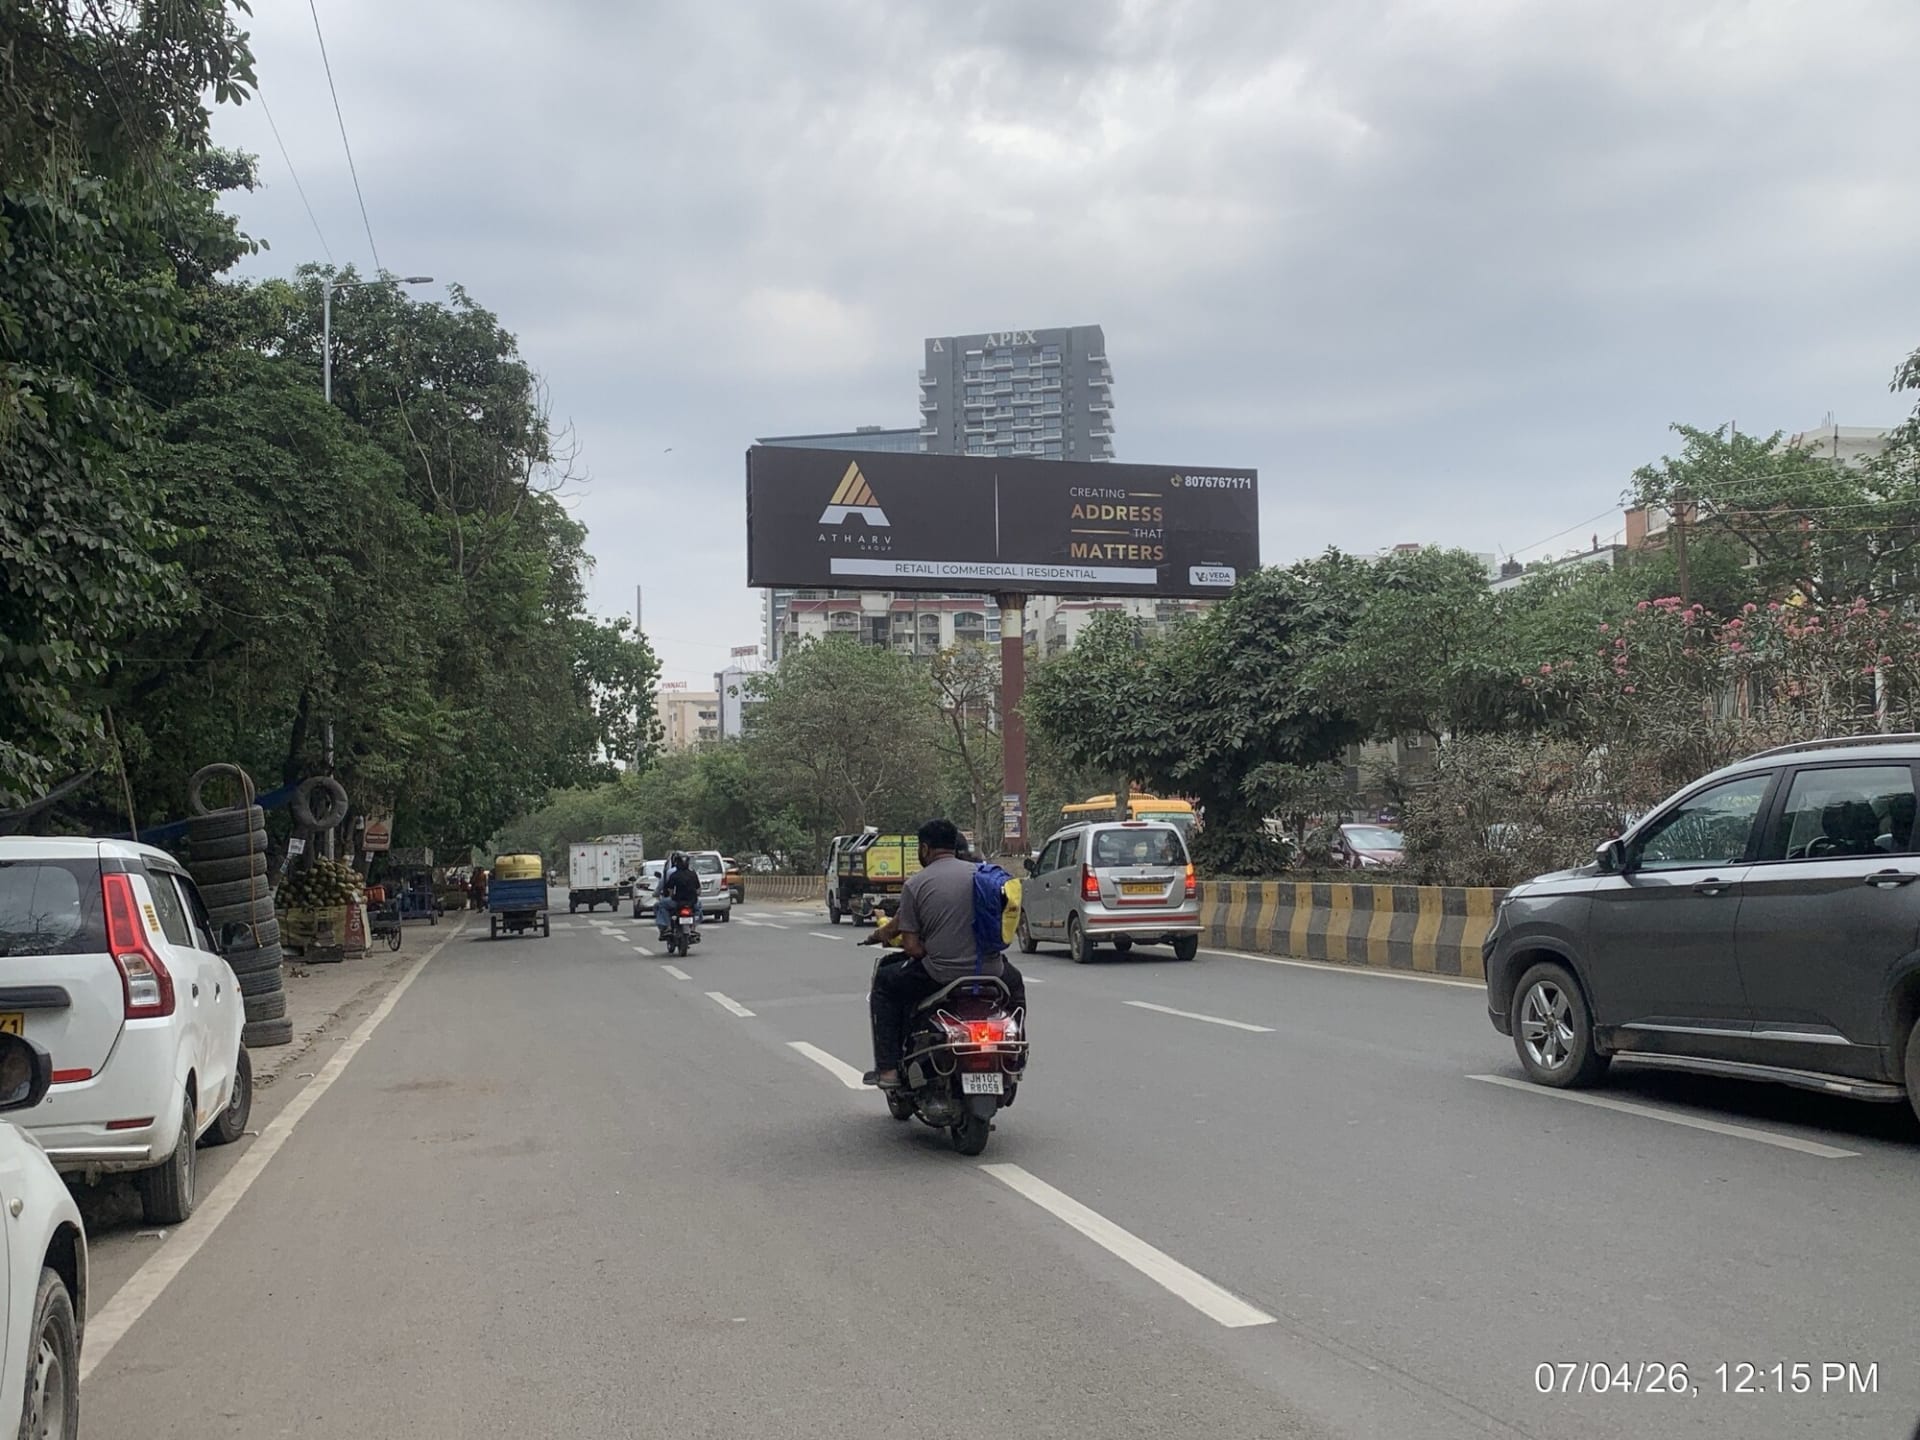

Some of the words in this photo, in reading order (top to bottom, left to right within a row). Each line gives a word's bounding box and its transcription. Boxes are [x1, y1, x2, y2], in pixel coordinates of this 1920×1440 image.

[985, 330, 1037, 348] APEX
[1184, 475, 1251, 489] 8076767171
[1069, 487, 1126, 499] CREATING
[1071, 504, 1163, 522] ADDRESS
[818, 533, 892, 544] ATHARV
[1133, 528, 1164, 539] THAT
[1071, 542, 1164, 561] MATTERS
[895, 563, 934, 575] RETAIL
[942, 564, 1018, 577] COMMERCIAL
[1026, 567, 1097, 579] RESIDENTIAL
[1209, 571, 1231, 579] VEDA
